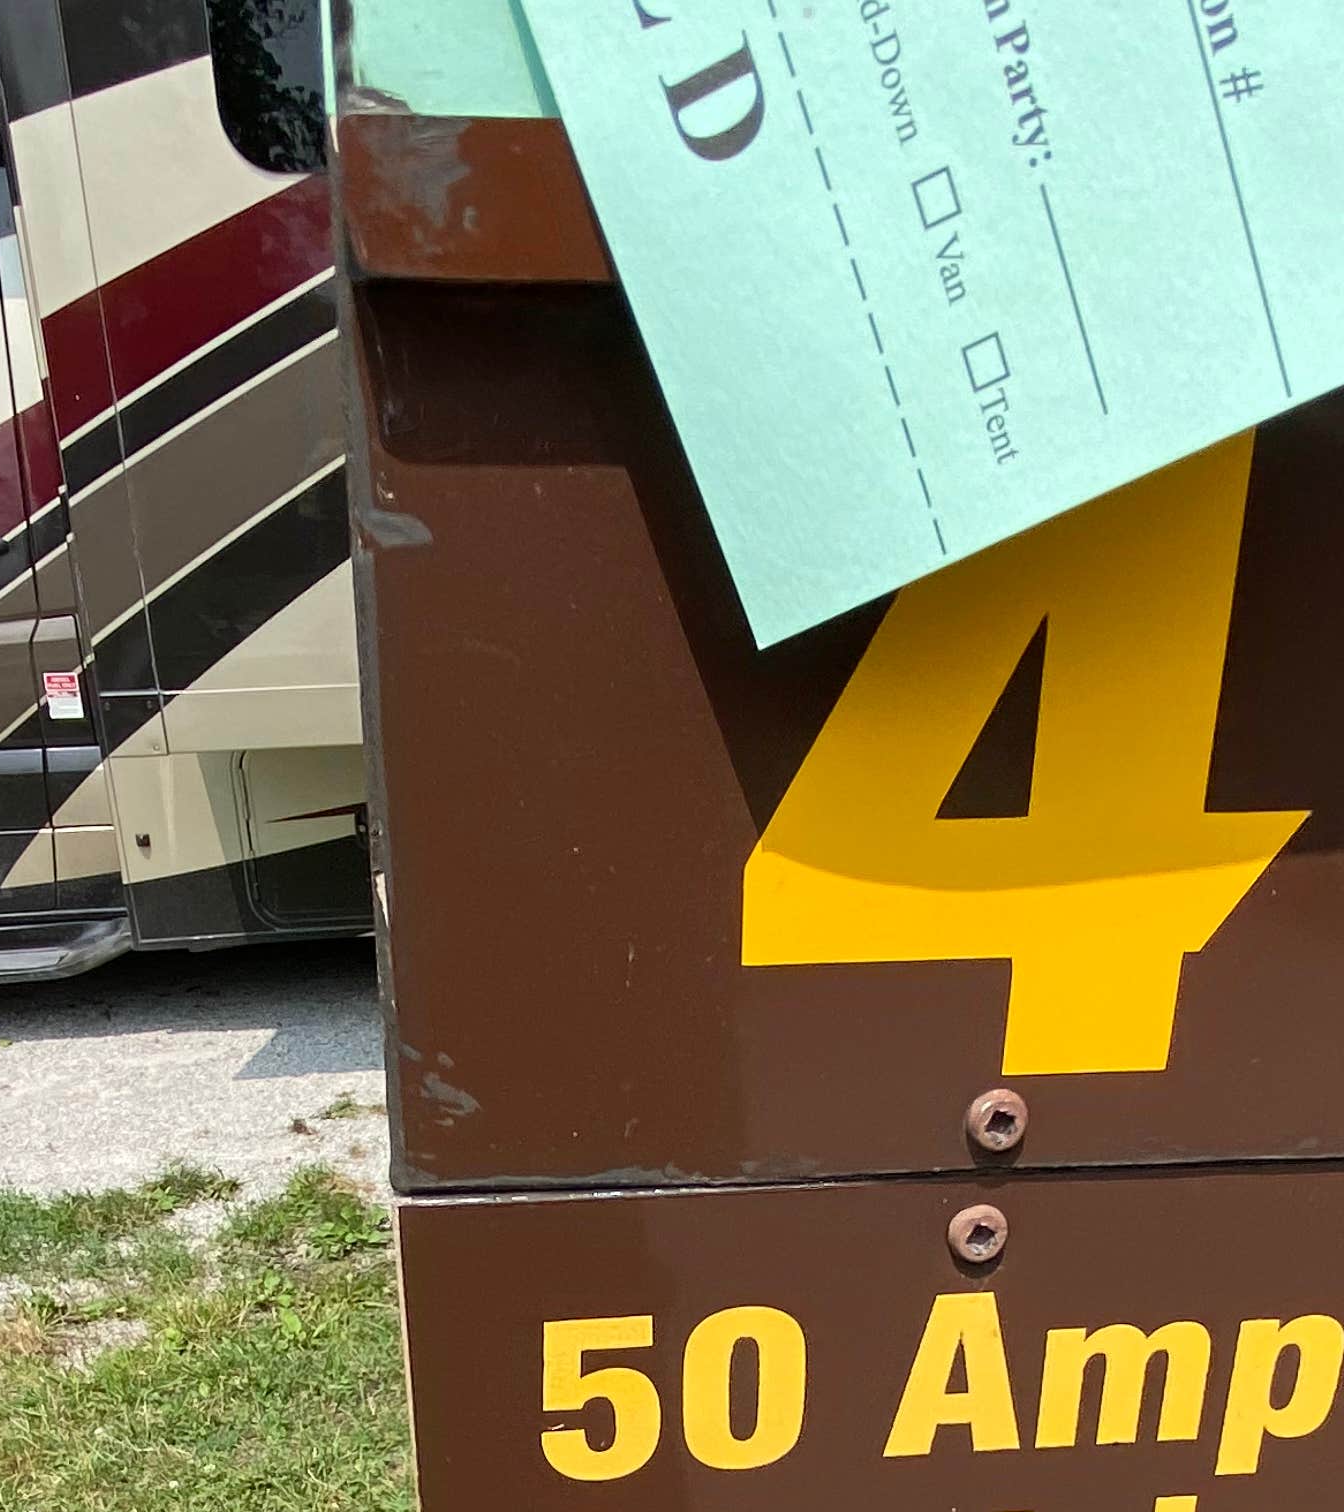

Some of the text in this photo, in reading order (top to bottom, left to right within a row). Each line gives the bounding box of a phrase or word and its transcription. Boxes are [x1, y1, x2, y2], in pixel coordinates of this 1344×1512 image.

[993, 19, 1053, 167] Party:
[1219, 67, 1264, 103] #
[936, 231, 967, 306] Van
[979, 387, 1019, 465] Tent
[741, 424, 1314, 1076] 4
[541, 1306, 807, 1482] 50
